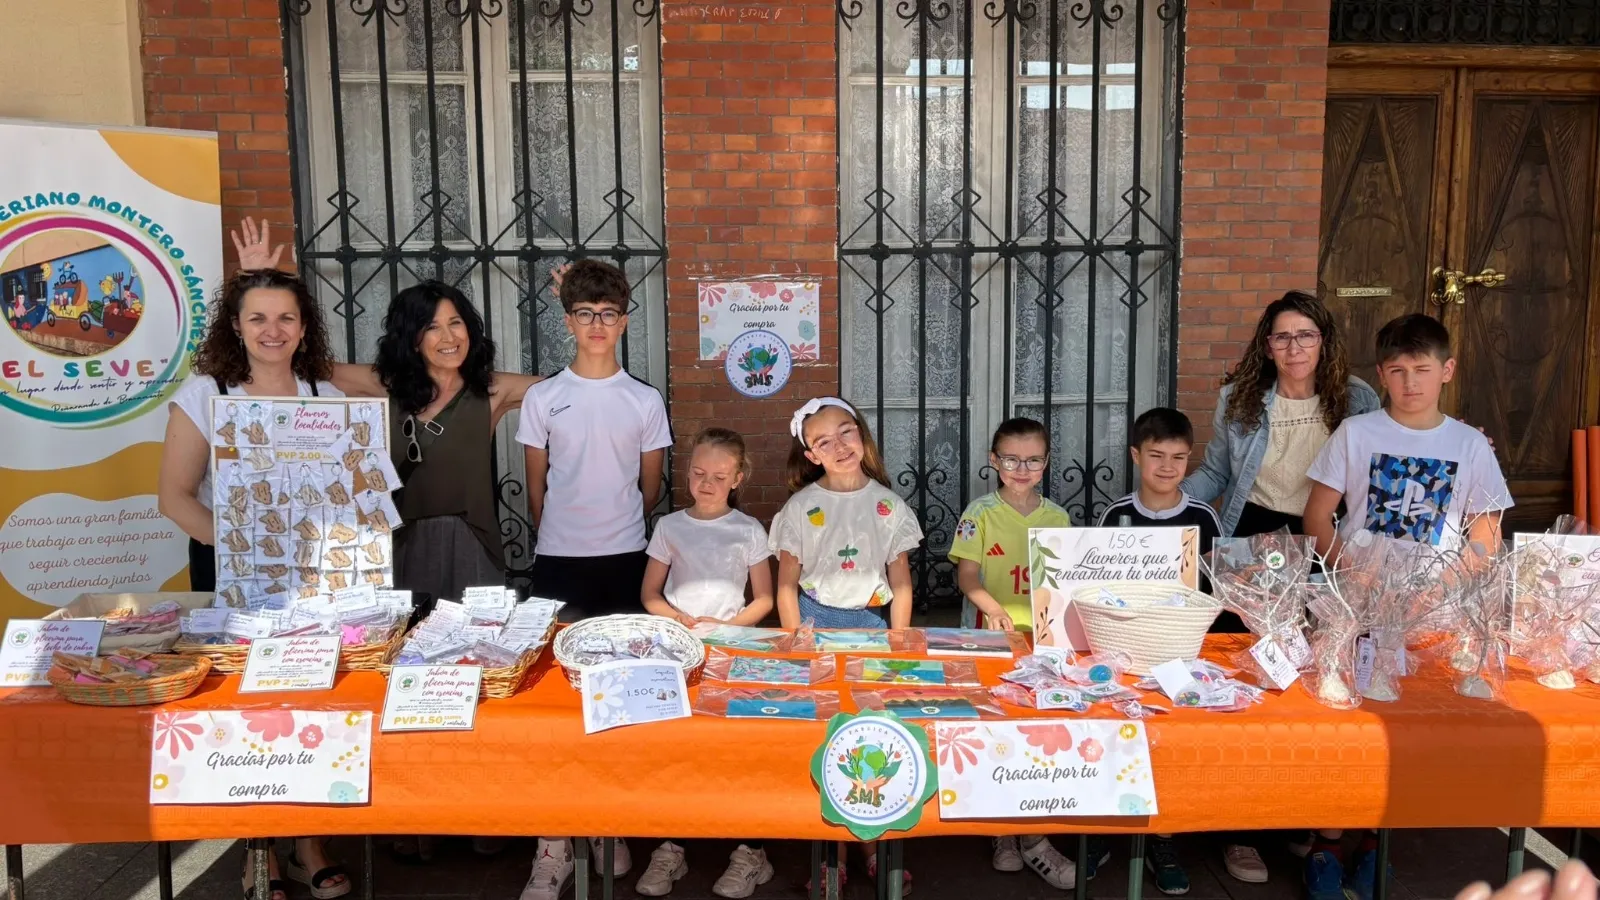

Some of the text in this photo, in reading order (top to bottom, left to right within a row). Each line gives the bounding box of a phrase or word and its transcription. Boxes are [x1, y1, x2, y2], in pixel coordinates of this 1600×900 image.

[88, 195, 185, 259] MONTERO
[729, 302, 790, 313] Gracias por tu
[743, 320, 776, 330] compra
[2, 360, 44, 378] EL
[294, 406, 330, 418] Llaveros
[294, 419, 342, 431] localidades
[276, 451, 297, 459] PVP
[299, 451, 321, 459] 2.00
[9, 507, 164, 528] Somos una gran familia
[26, 535, 76, 550] trabaja
[78, 536, 95, 545] en
[97, 531, 141, 547] equipo
[142, 530, 175, 544] para
[1107, 531, 1136, 549] 1,50
[28, 551, 148, 573] seguir creciendo y
[1073, 547, 1168, 571] Llaveros que
[1054, 565, 1178, 581] encantan tu vida
[26, 572, 152, 595] aprendiendo juntos
[393, 716, 417, 725] PVP
[206, 750, 315, 770] Gracias por tu
[992, 764, 1099, 784] Gracias por tu
[228, 783, 289, 799] compra
[1019, 796, 1079, 814] compra
